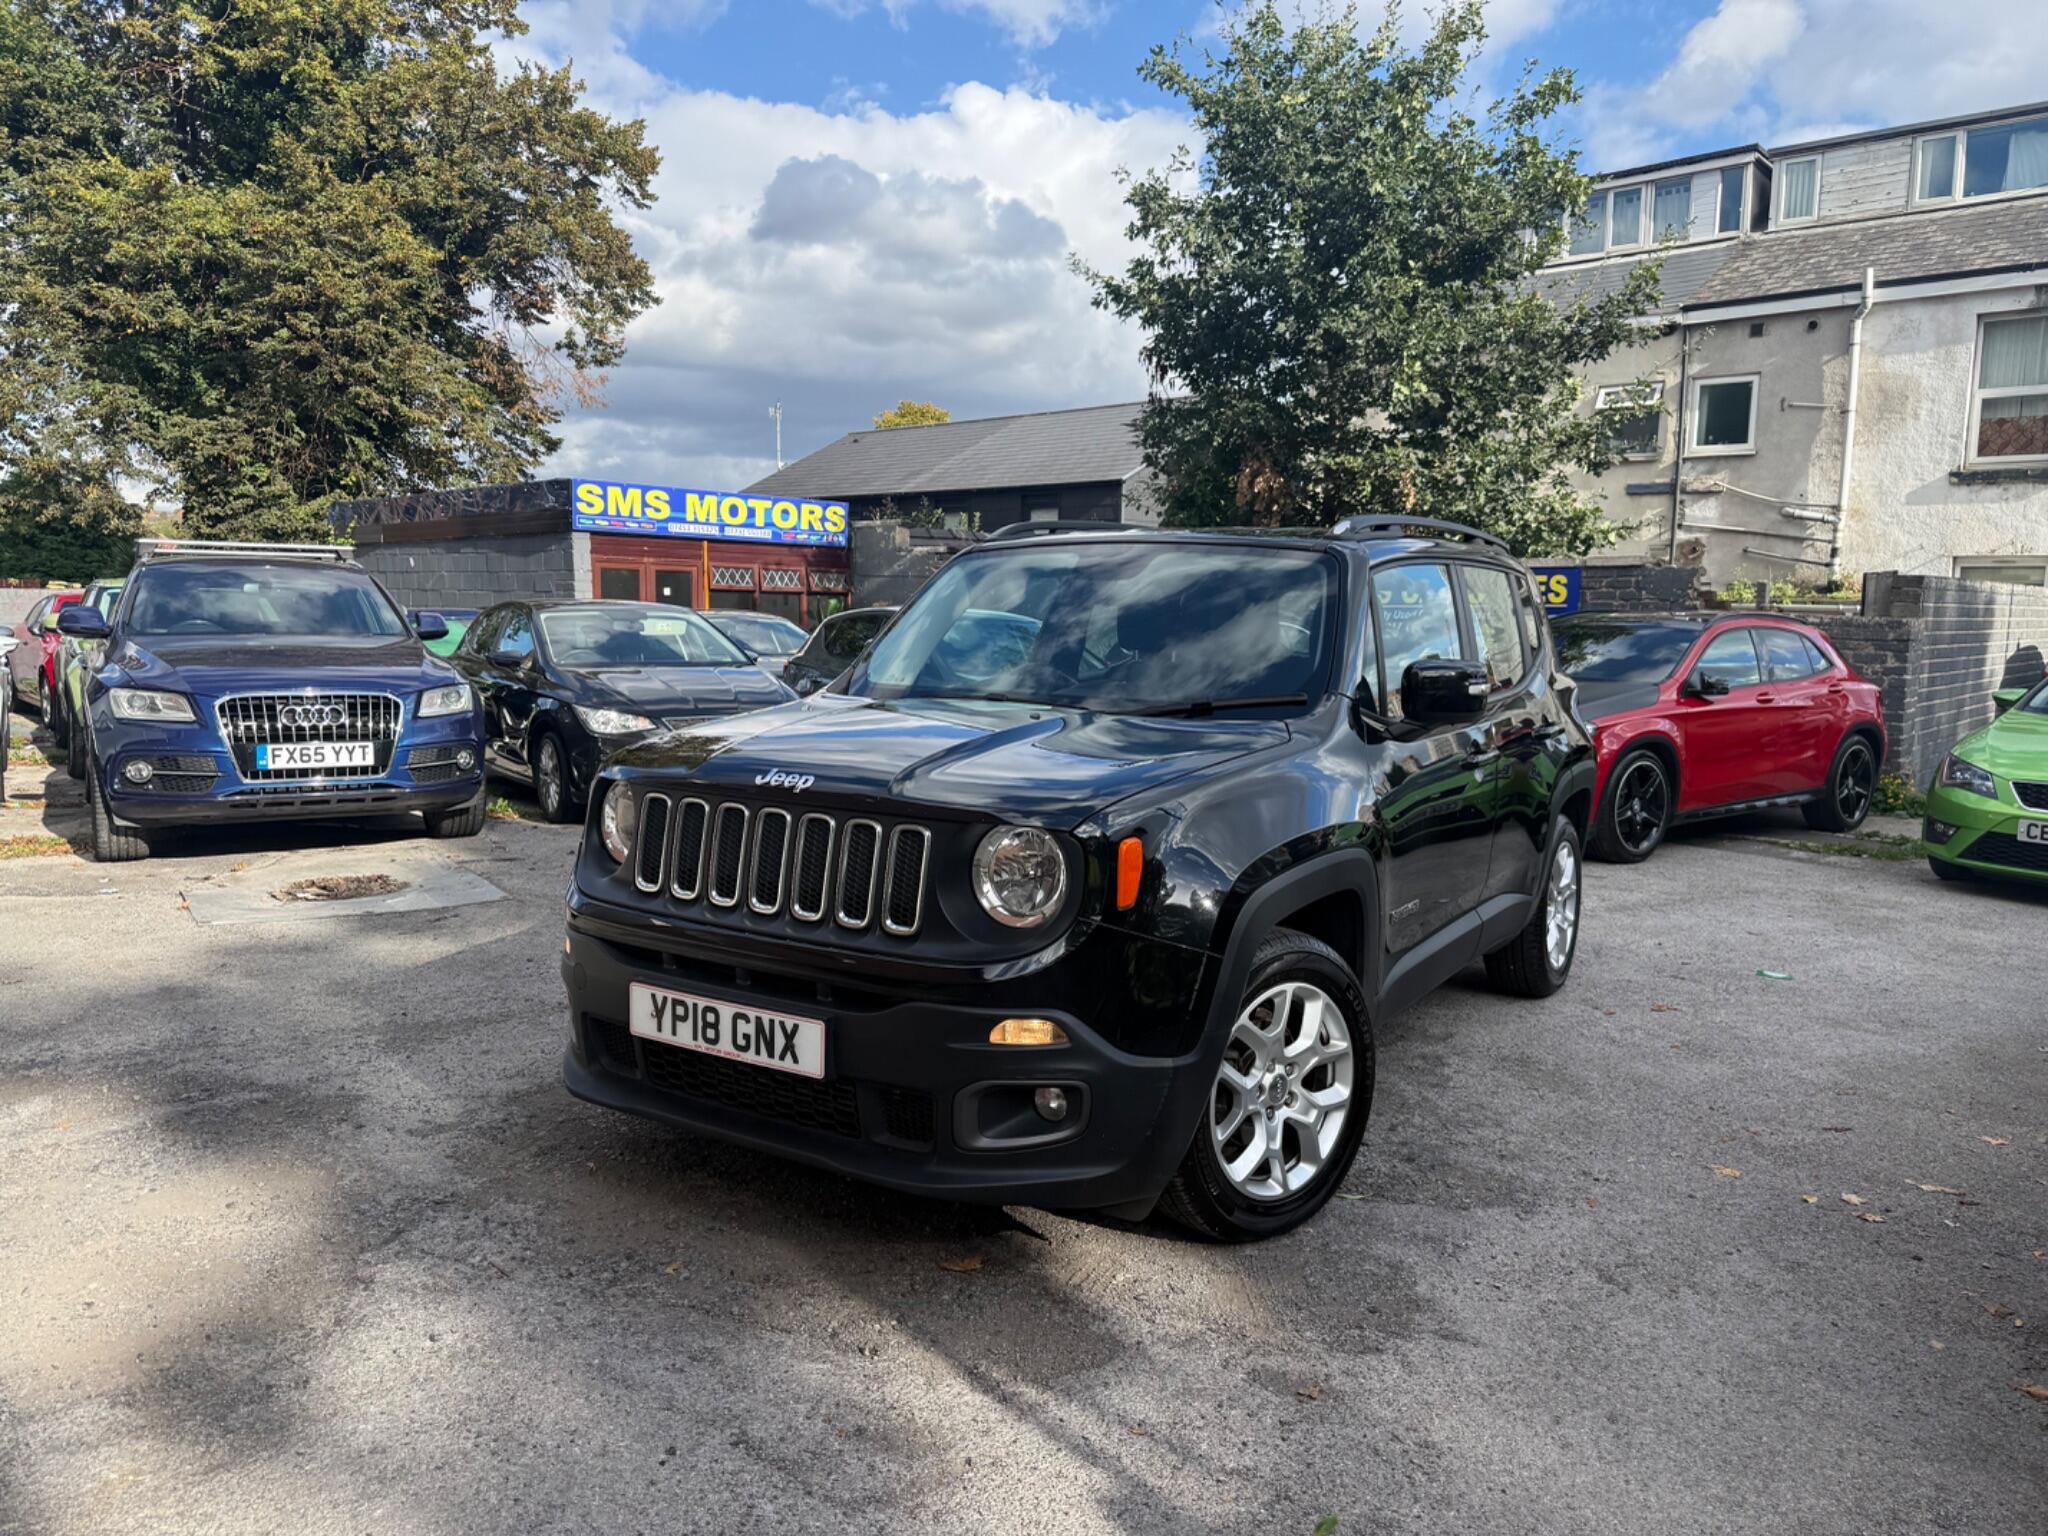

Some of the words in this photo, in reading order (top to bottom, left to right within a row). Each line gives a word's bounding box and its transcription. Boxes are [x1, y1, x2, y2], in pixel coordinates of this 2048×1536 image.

[576, 483, 671, 520] SMS
[685, 493, 846, 533] MOTORS
[271, 746, 325, 765] FX65
[331, 745, 370, 763] YYT
[755, 768, 815, 793] Jeep
[650, 993, 720, 1046] YP18
[731, 1011, 799, 1065] GNX
